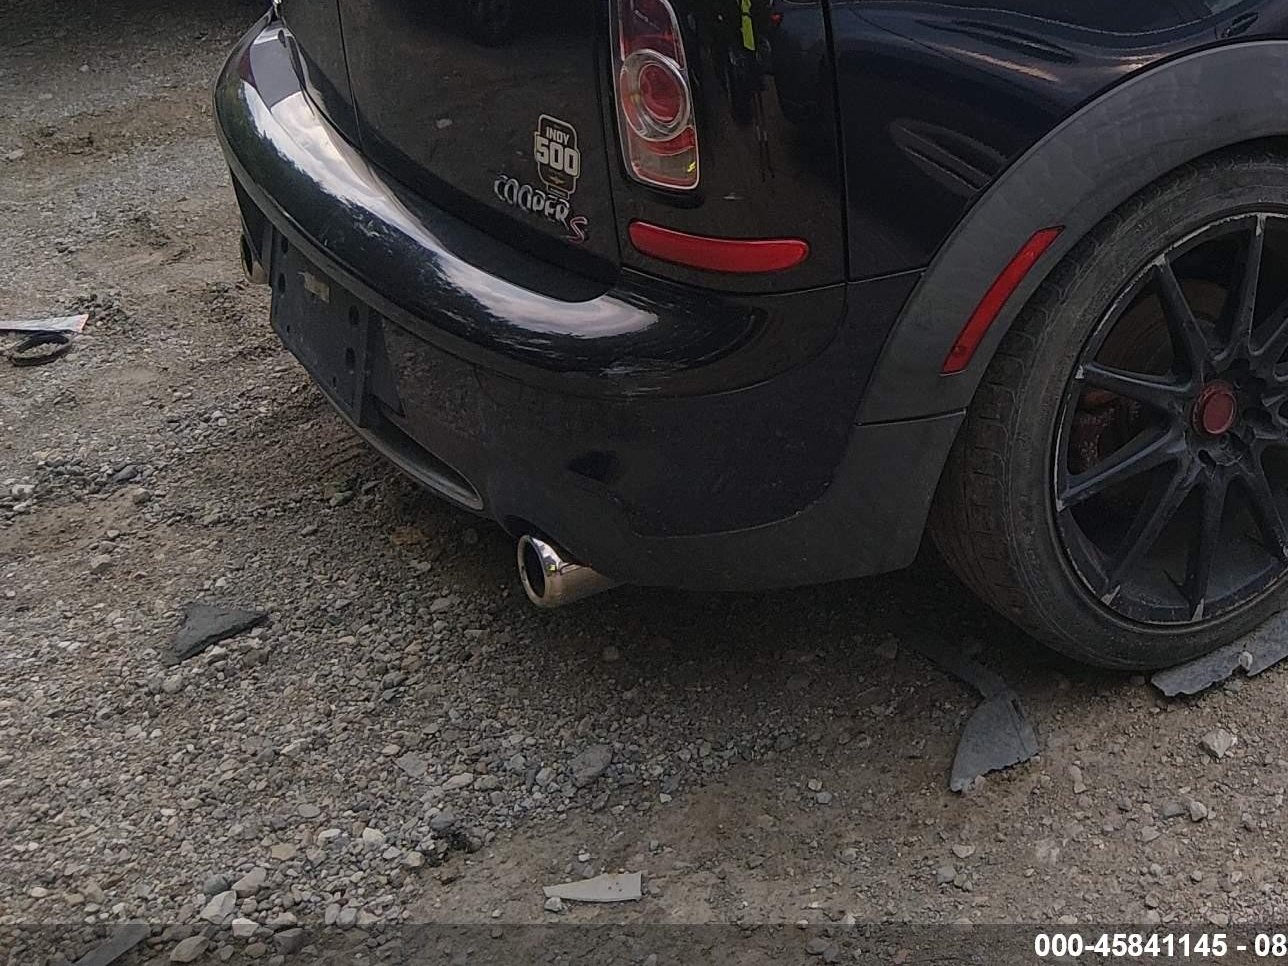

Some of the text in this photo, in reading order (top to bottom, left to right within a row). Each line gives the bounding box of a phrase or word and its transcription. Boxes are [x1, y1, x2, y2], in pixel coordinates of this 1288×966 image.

[536, 135, 579, 176] 500
[545, 126, 570, 146] INDY
[494, 175, 588, 243] COOPER S
